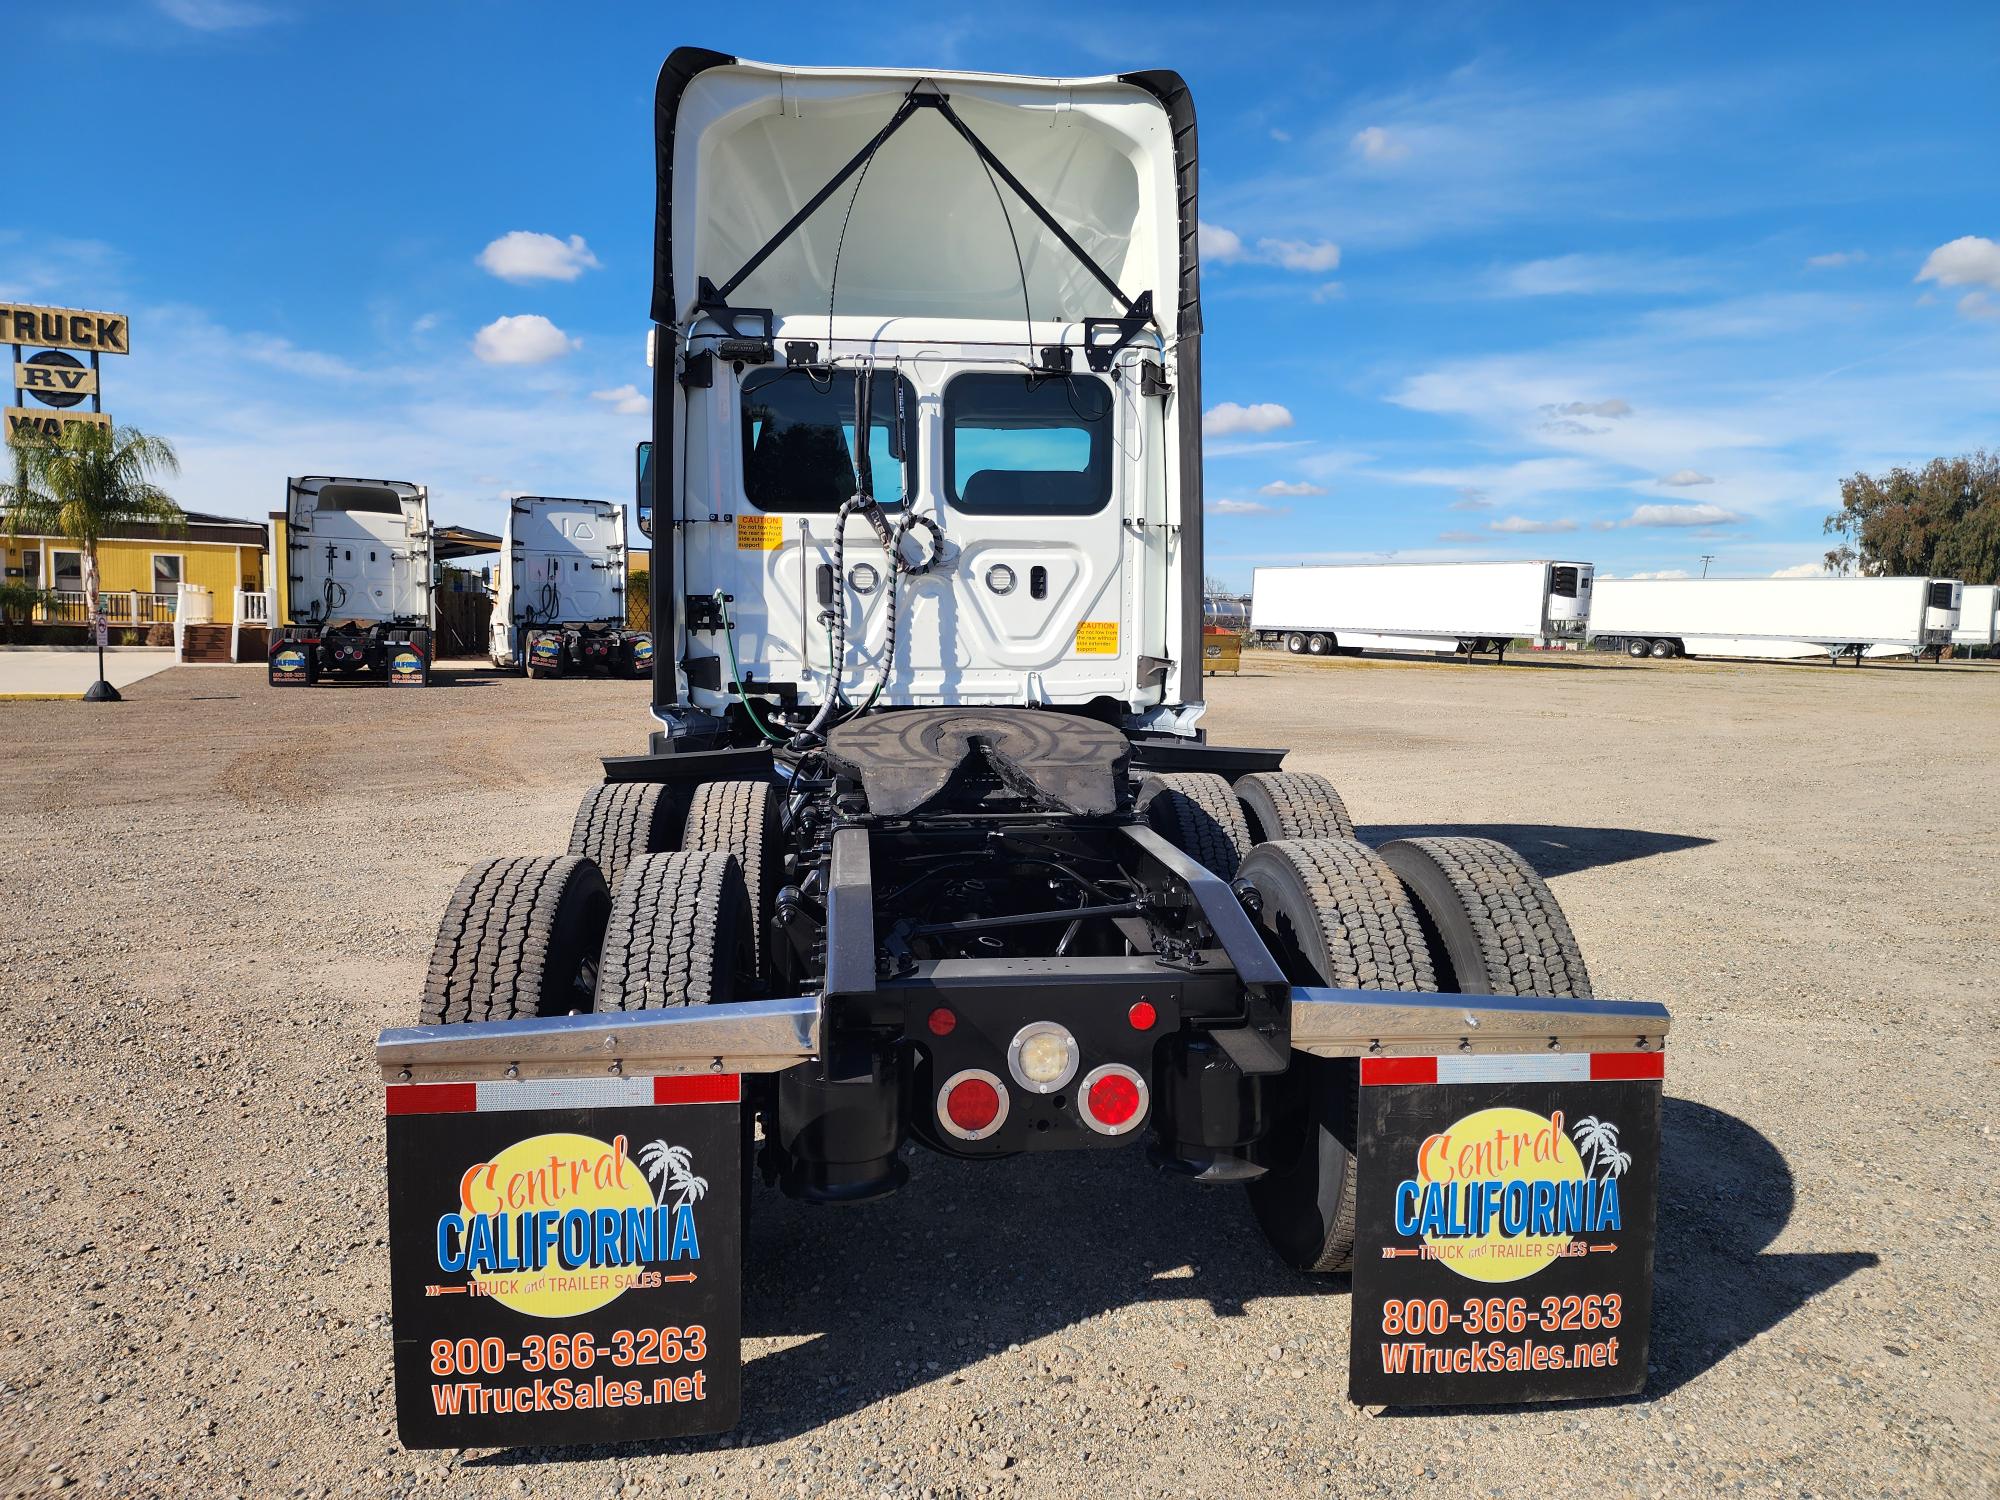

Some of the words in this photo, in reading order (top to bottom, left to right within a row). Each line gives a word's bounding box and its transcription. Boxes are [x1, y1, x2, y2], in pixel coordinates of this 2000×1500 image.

[23, 367, 88, 389] RV
[742, 516, 779, 524] CAUTION
[1417, 1110, 1565, 1186] Central
[460, 1134, 635, 1217] Central
[1395, 1177, 1622, 1237] CALIFORNIA
[437, 1203, 700, 1273] CALIFORNIA
[1418, 1244, 1464, 1260] TRUCK
[1467, 1241, 1488, 1259] and
[1489, 1243, 1542, 1259] TRAILER
[1545, 1241, 1588, 1258] SALES
[467, 1280, 519, 1297] TRUCK
[523, 1273, 546, 1294] and
[549, 1275, 610, 1292] TRAILER
[614, 1271, 662, 1289] SALES
[1382, 1293, 1622, 1335] 800-366-3263
[430, 1324, 708, 1376] 800-366-3263
[1381, 1336, 1619, 1374] WTruckSales.net
[430, 1369, 707, 1416] WTruckSales.net
